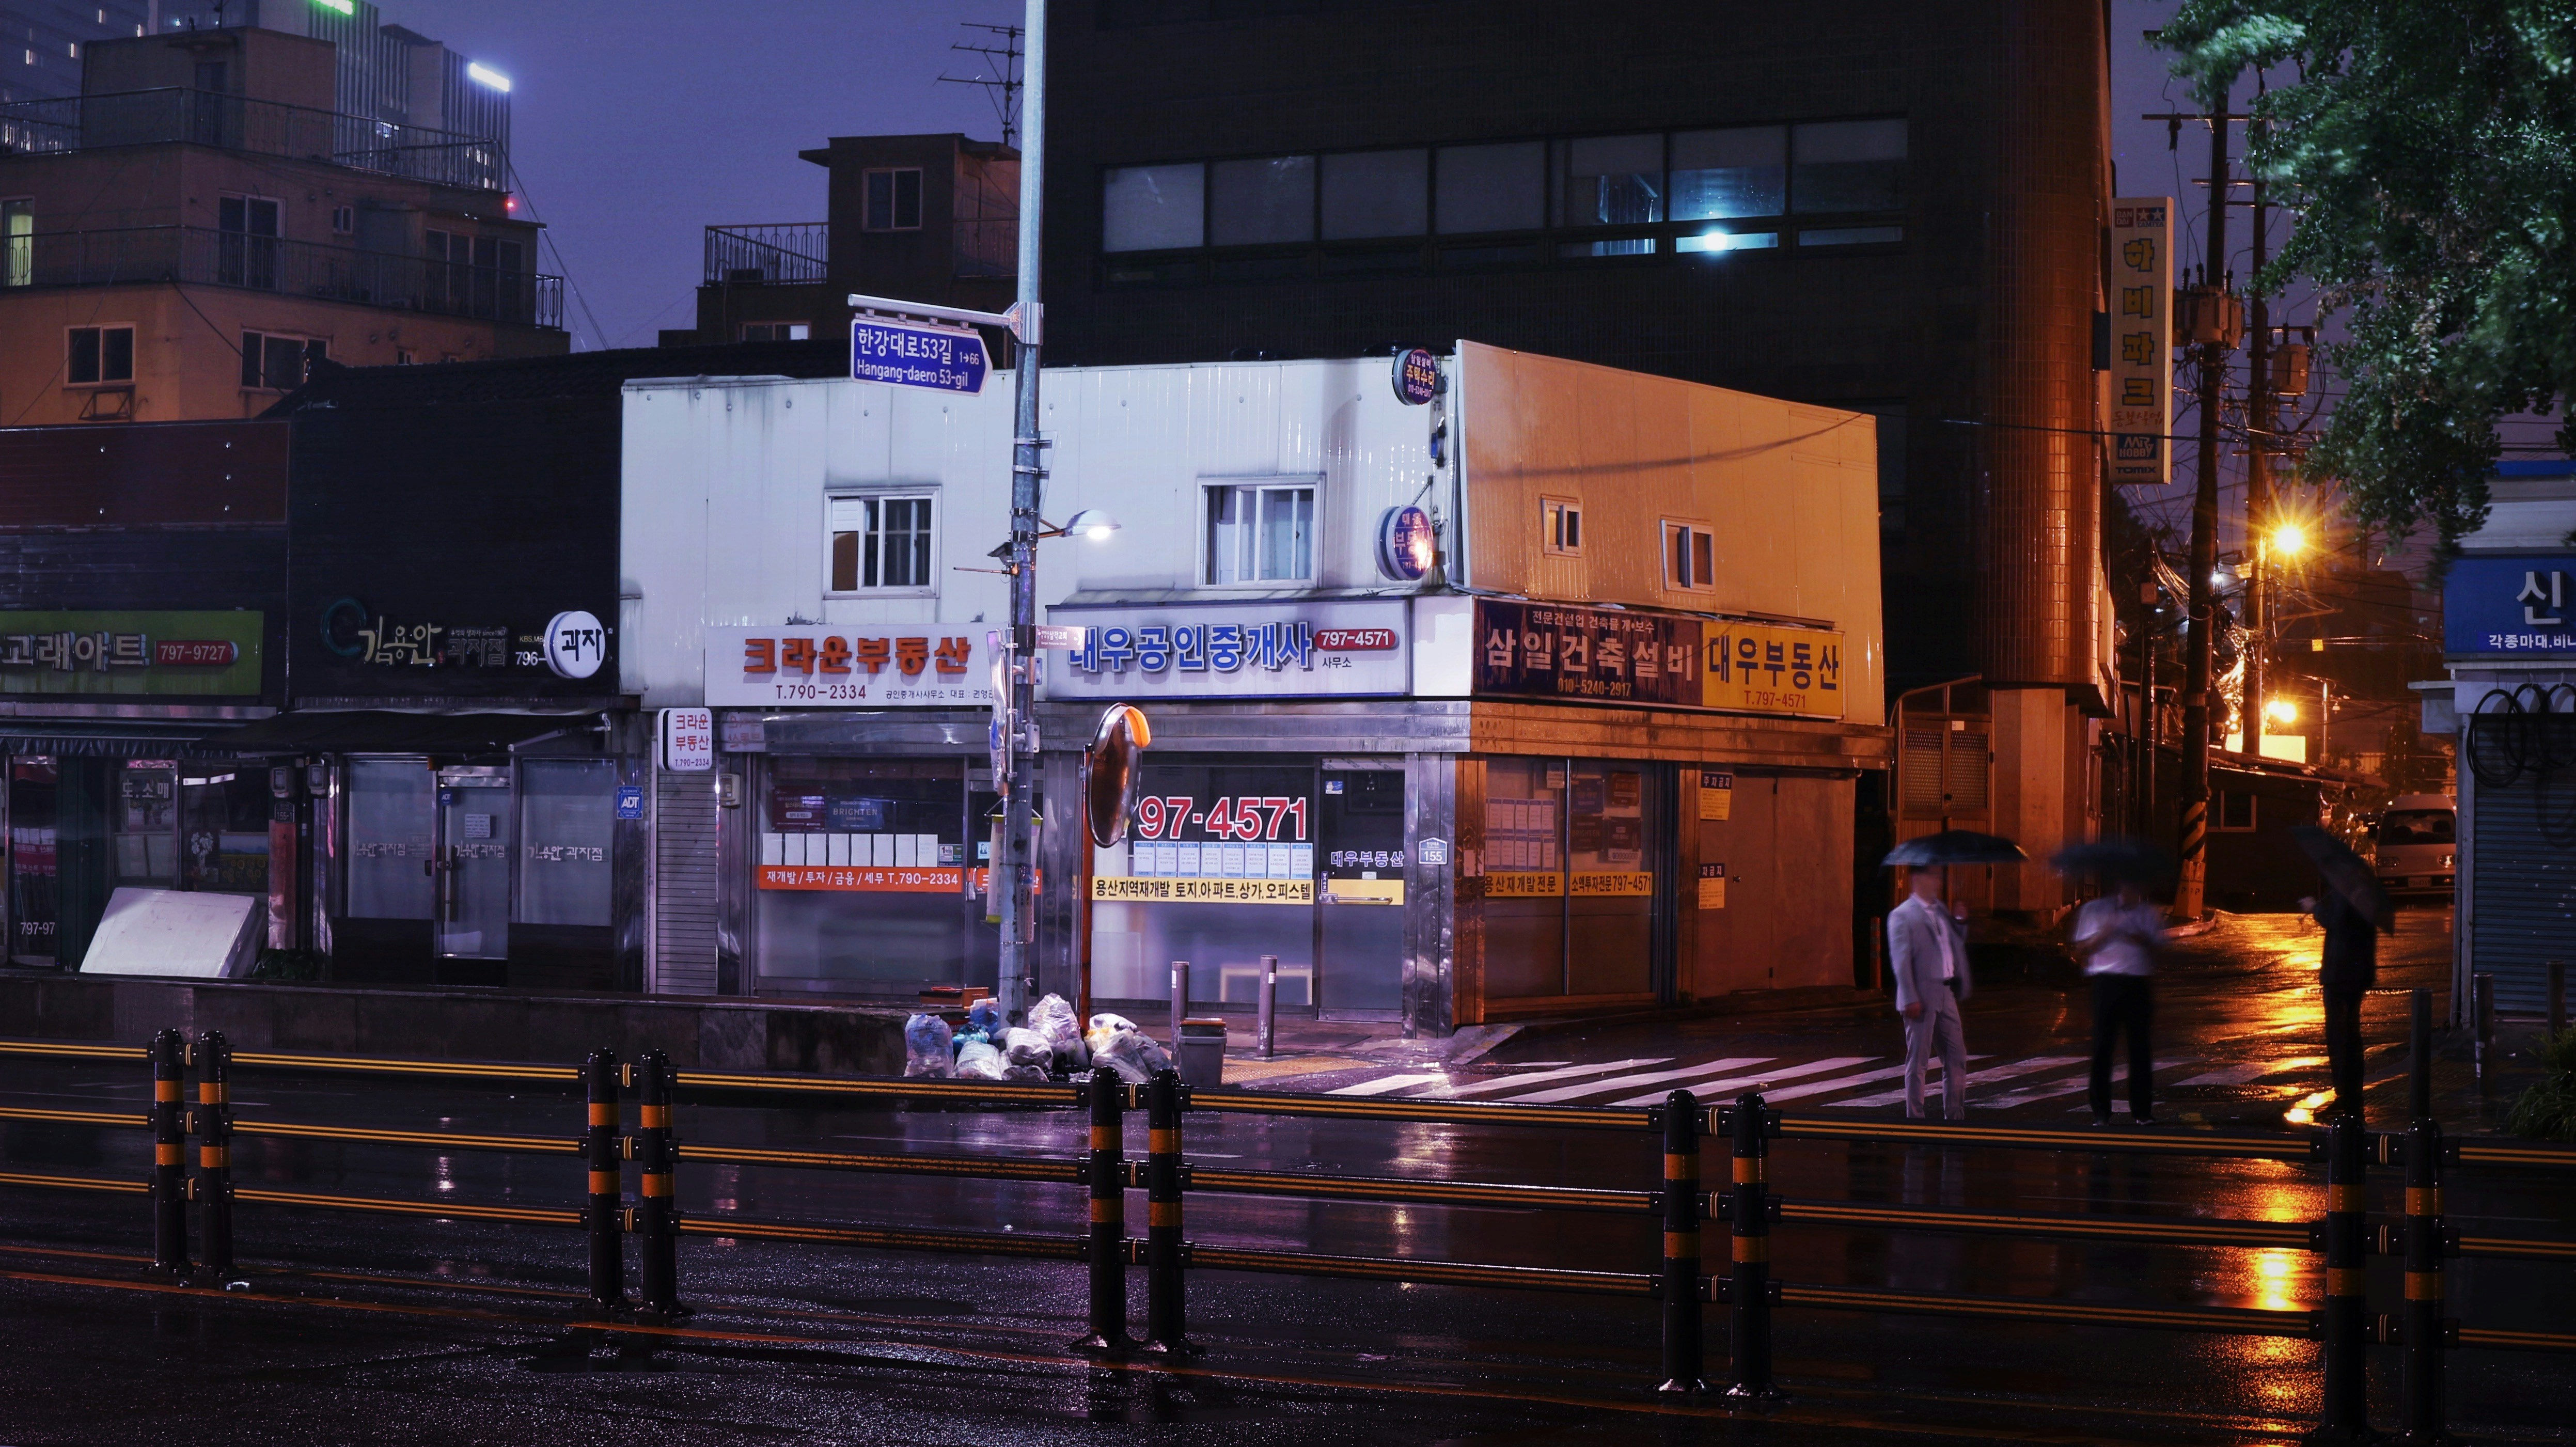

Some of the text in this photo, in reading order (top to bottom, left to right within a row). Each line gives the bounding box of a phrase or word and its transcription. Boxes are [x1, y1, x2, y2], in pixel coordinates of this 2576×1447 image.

[2123, 238, 2155, 407] 하비파크
[858, 328, 952, 365] 한강대로53길
[857, 358, 968, 389] Hangang-daero 53-gil
[1406, 364, 1435, 389] 주택수리
[2119, 444, 2155, 458] HOBBY
[2516, 571, 2565, 625] 신
[1532, 610, 1585, 628] 전문건설업
[1589, 616, 1619, 632] 건축물
[358, 615, 443, 666] 김용안
[561, 628, 602, 662] 과자
[1068, 622, 1314, 672] 대우공인중개사
[1320, 631, 1391, 646] 797-4571
[1, 631, 150, 672] 고래아트
[160, 645, 226, 660] 797-9727
[447, 638, 506, 667] 과자점
[744, 635, 971, 675] 크라운부동산
[1485, 628, 1692, 681] 삼일건축설비
[1322, 657, 1352, 669] 사무소
[1709, 635, 1839, 690] 대우부동산
[776, 684, 867, 700] T.790-2334
[886, 690, 945, 700] 공인중개사사무소
[1558, 678, 1632, 697] 010-5240-2917
[1744, 690, 1806, 709] T.797-4571
[676, 714, 709, 730] 크라운
[676, 735, 709, 751] 부동산
[675, 758, 710, 767] T.790-2334
[621, 796, 640, 809] ADT
[833, 808, 877, 816] BRIGHTEN
[277, 811, 292, 821] 155-1
[1121, 795, 1306, 841] 97-4571
[379, 842, 405, 856] 과자점
[481, 843, 505, 857] 과자점
[527, 842, 604, 861] 김용안 과자점
[1424, 851, 1442, 861] 155
[1331, 851, 1404, 868] 대우부동산
[766, 870, 796, 885] 재개발
[805, 871, 825, 885] 투자
[835, 872, 855, 886] 금융
[864, 872, 884, 885] 세무
[887, 872, 959, 885] T.790-2334
[1699, 866, 1722, 876] 차금지
[1095, 879, 1311, 901] 용산지역재개발 토지.아파트.상가.오피스텔
